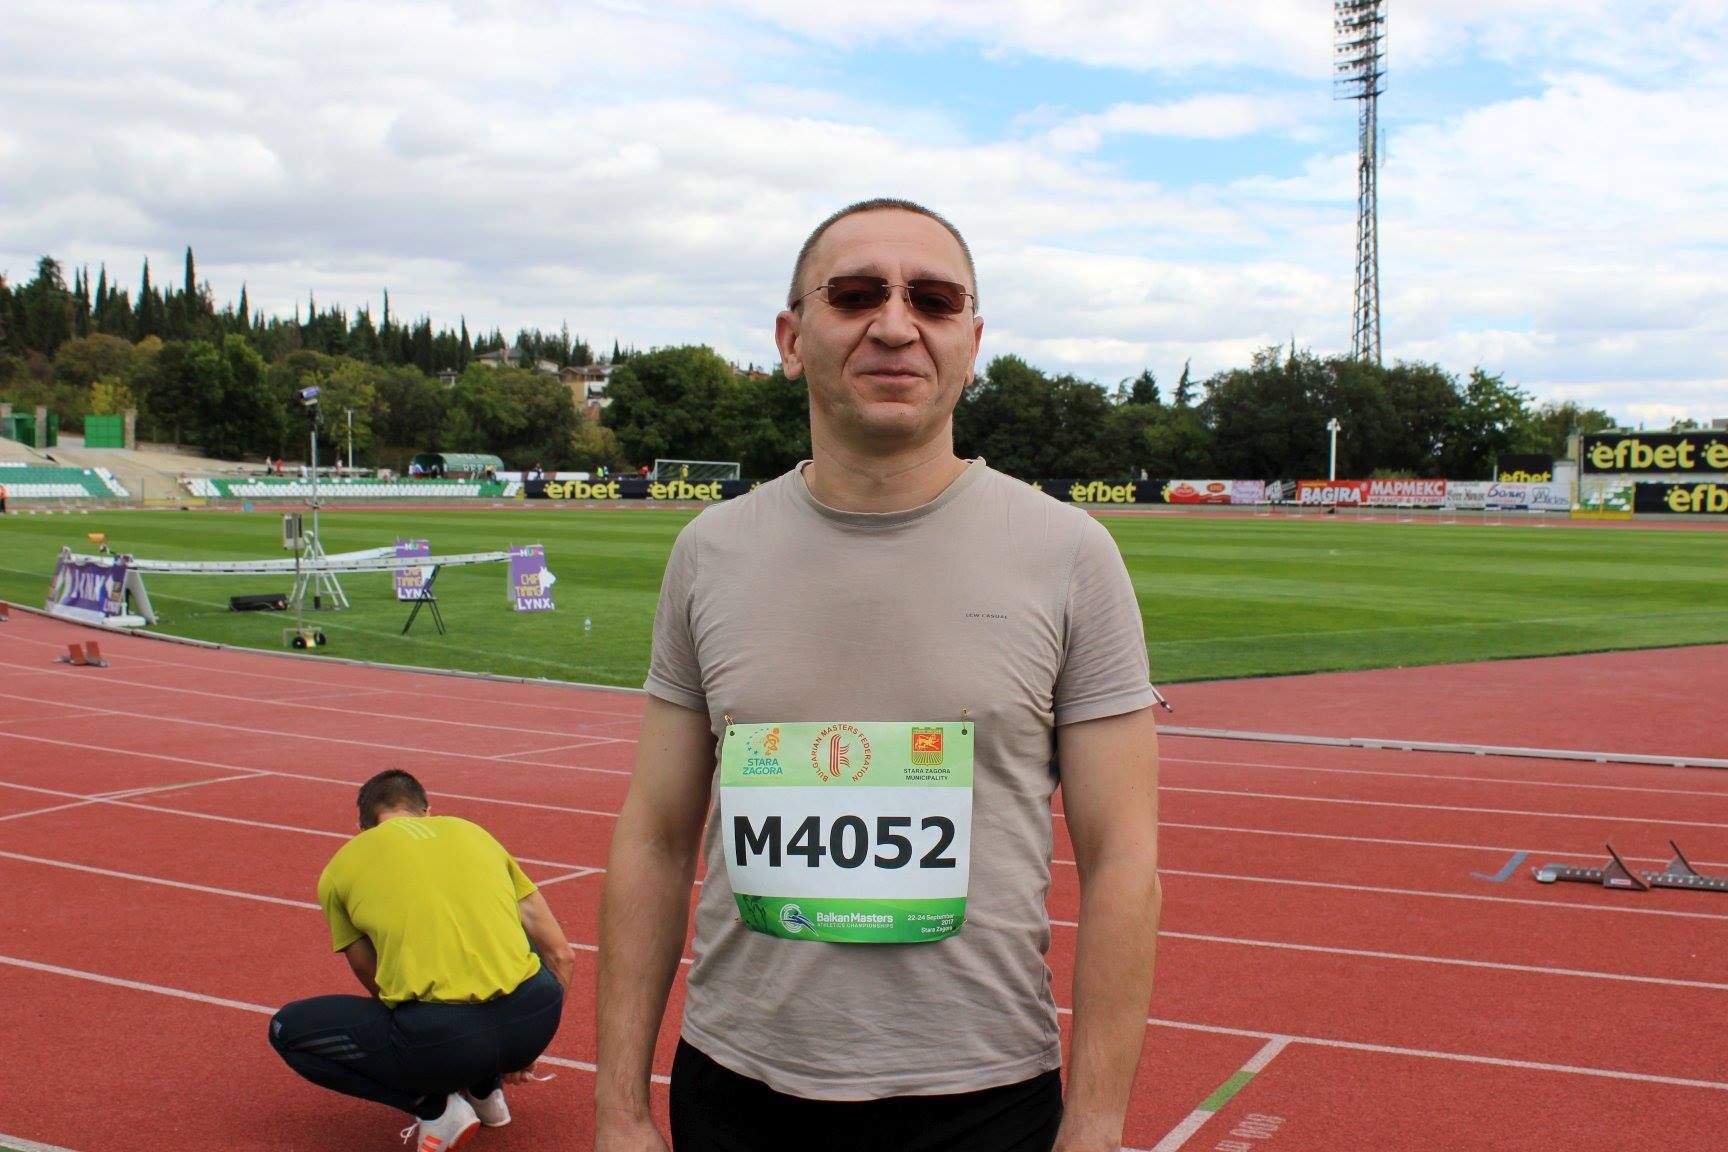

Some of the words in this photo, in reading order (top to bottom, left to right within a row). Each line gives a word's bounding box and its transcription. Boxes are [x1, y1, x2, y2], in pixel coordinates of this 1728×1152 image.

[1589, 439, 1694, 468] efbet
[545, 480, 620, 499] efbet
[650, 480, 722, 499] efbet
[1071, 480, 1136, 502] efbet
[1301, 487, 1361, 503] BAGIRA
[1370, 481, 1443, 495] МАРМЕКС
[1667, 484, 1728, 512] efb
[518, 598, 551, 610] LYNX
[747, 758, 778, 766] STARA
[811, 736, 829, 782] BULGARIAN
[821, 724, 858, 737] MASTERS
[851, 733, 871, 782] FEDERATION
[742, 767, 783, 775] ZAGORA
[734, 815, 956, 869] M4052
[816, 911, 850, 922] Balkan
[851, 912, 894, 923] Masters
